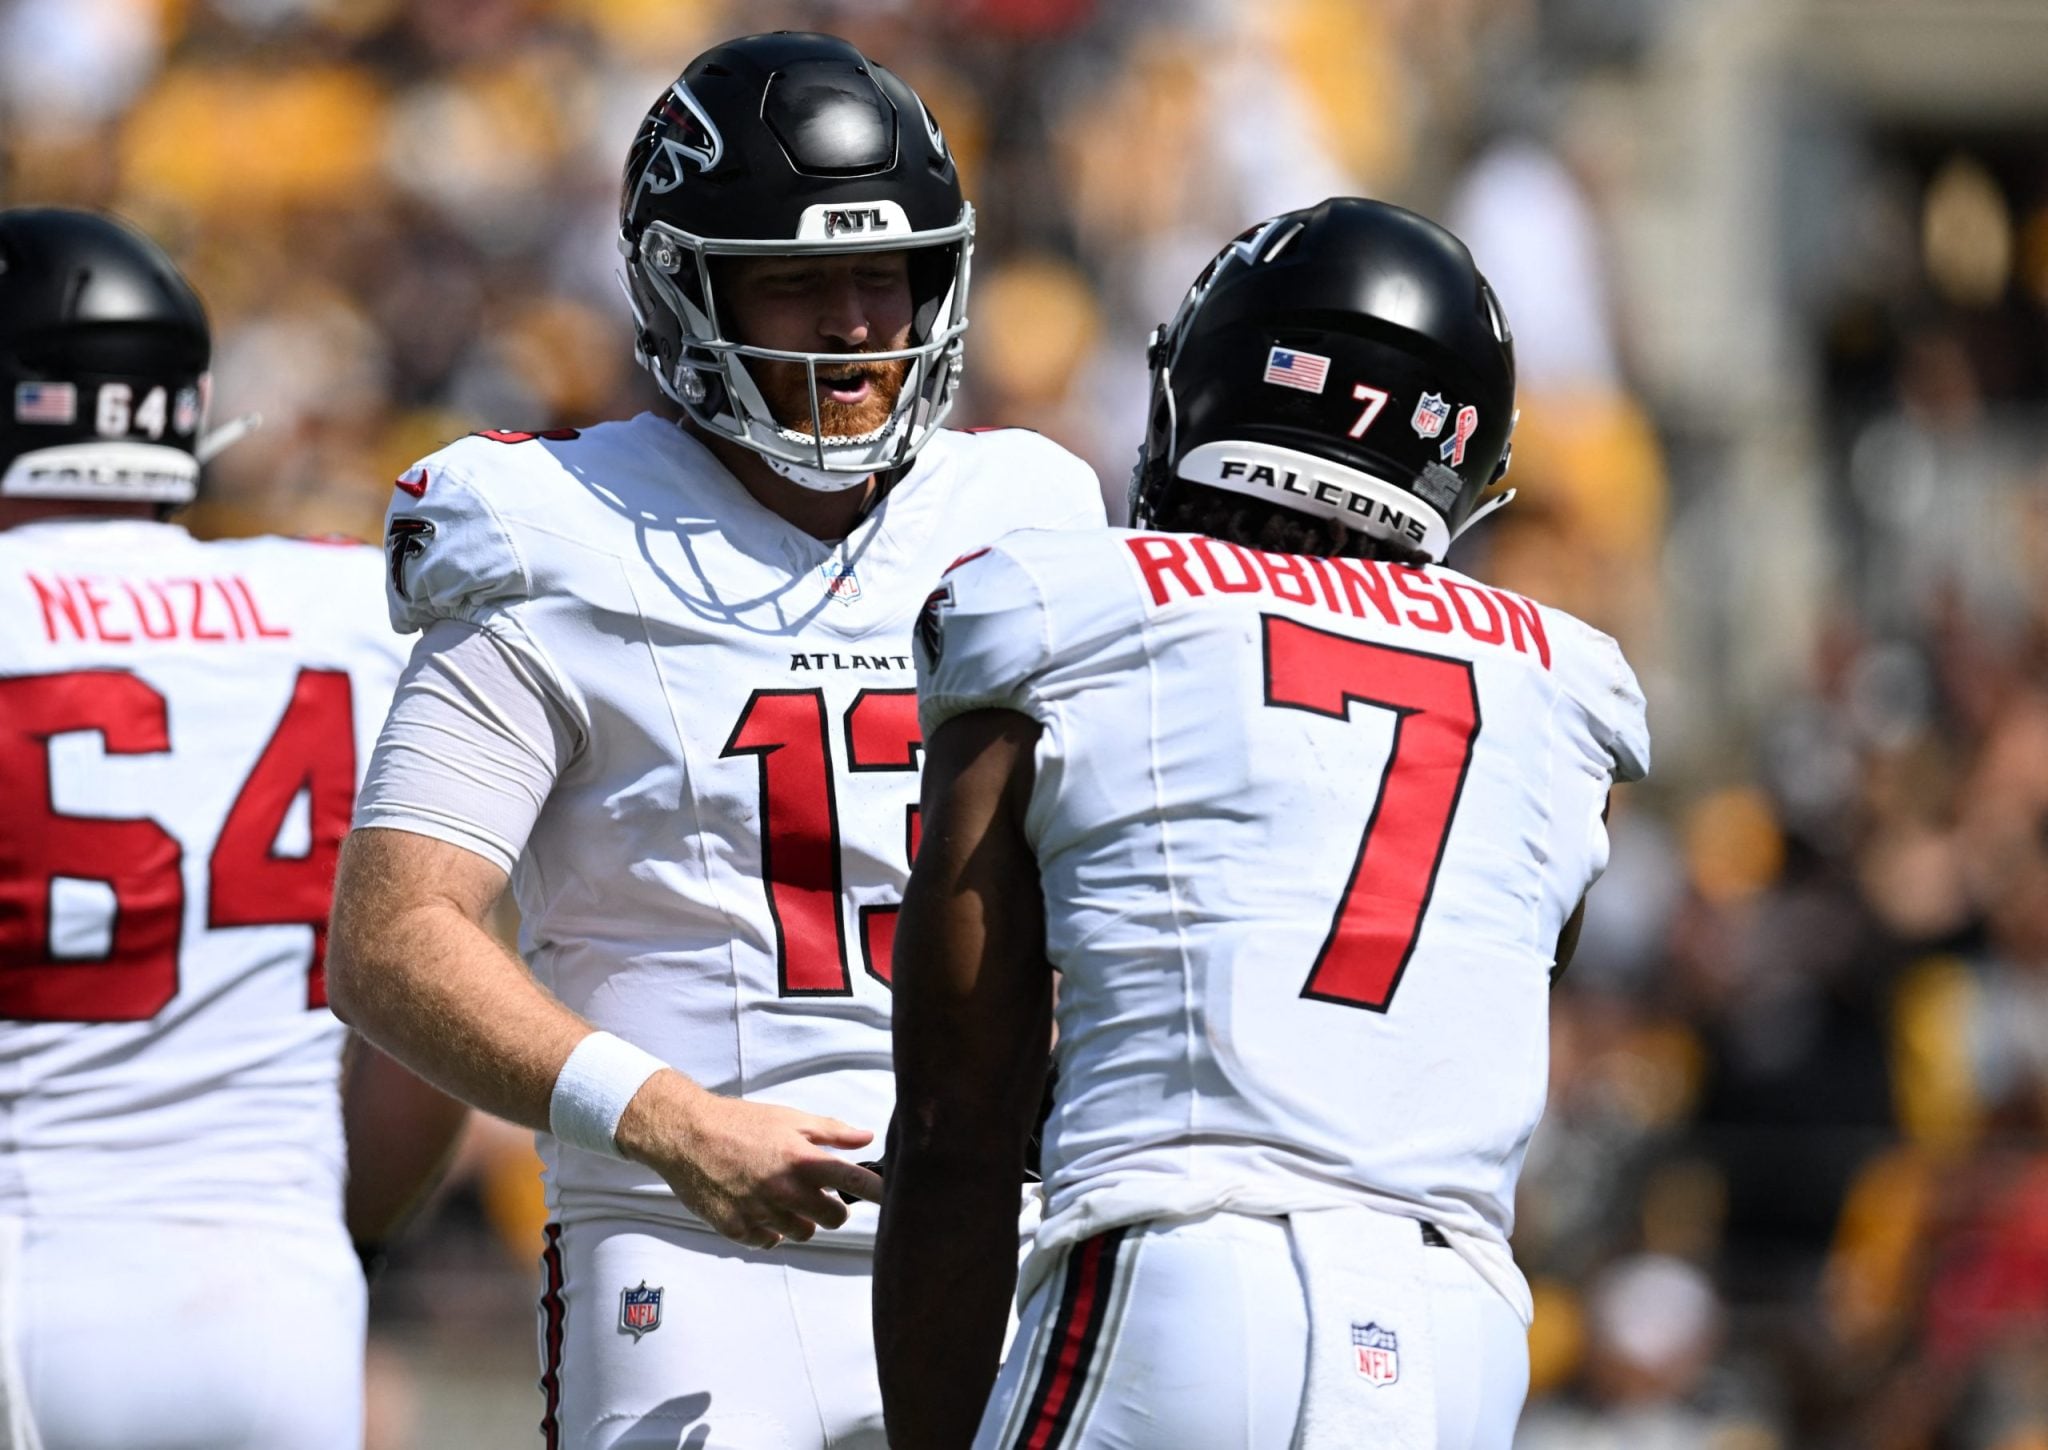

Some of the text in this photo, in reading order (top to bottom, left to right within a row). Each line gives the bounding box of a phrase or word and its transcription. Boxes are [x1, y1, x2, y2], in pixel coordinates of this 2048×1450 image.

[823, 208, 888, 238] ATL
[95, 383, 168, 440] 64
[1349, 384, 1390, 439] 7
[1416, 409, 1440, 433] NFL
[1220, 460, 1428, 545] FALCONS
[26, 572, 291, 644] NEUZIL
[1125, 535, 1552, 671] ROBINSON
[790, 653, 917, 671] ATLANT
[1260, 612, 1482, 1014] 7
[0, 665, 356, 1023] 64
[628, 1304, 655, 1327] NFL
[1358, 1348, 1393, 1379] NFL
